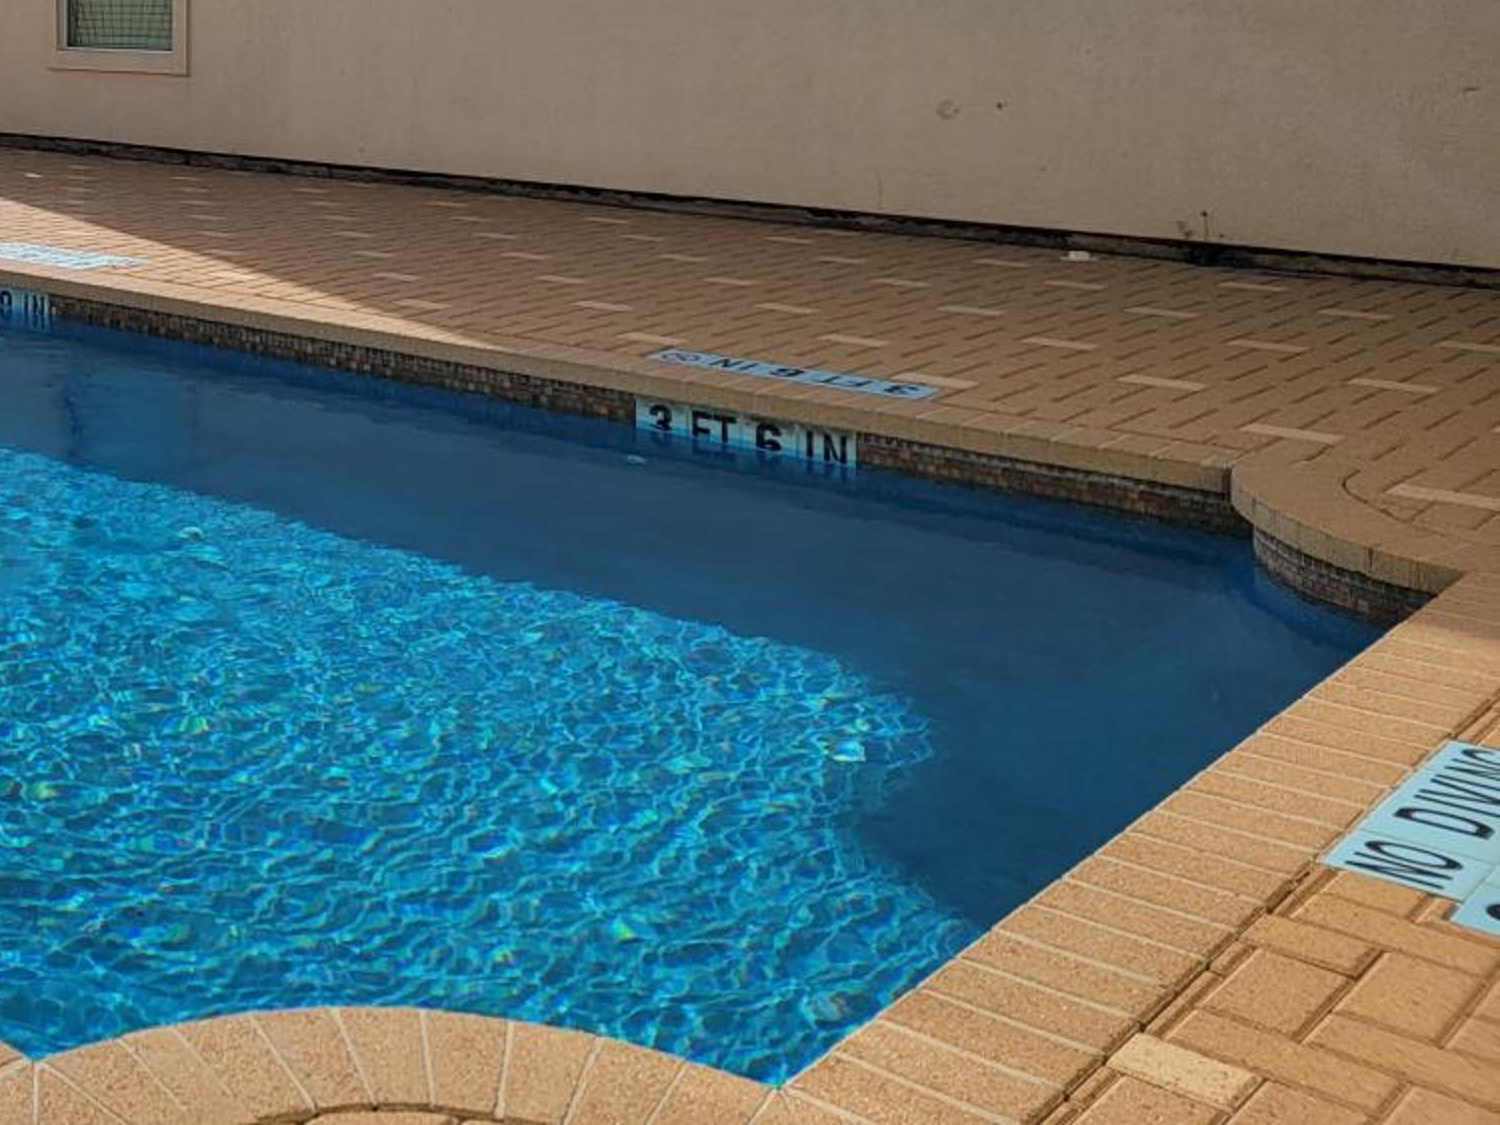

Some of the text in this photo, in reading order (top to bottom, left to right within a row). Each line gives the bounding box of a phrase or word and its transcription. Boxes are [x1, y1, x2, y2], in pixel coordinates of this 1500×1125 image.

[708, 357, 751, 371] IN
[649, 404, 847, 464] 3 FT 6 IN
[1344, 840, 1464, 890] NO
